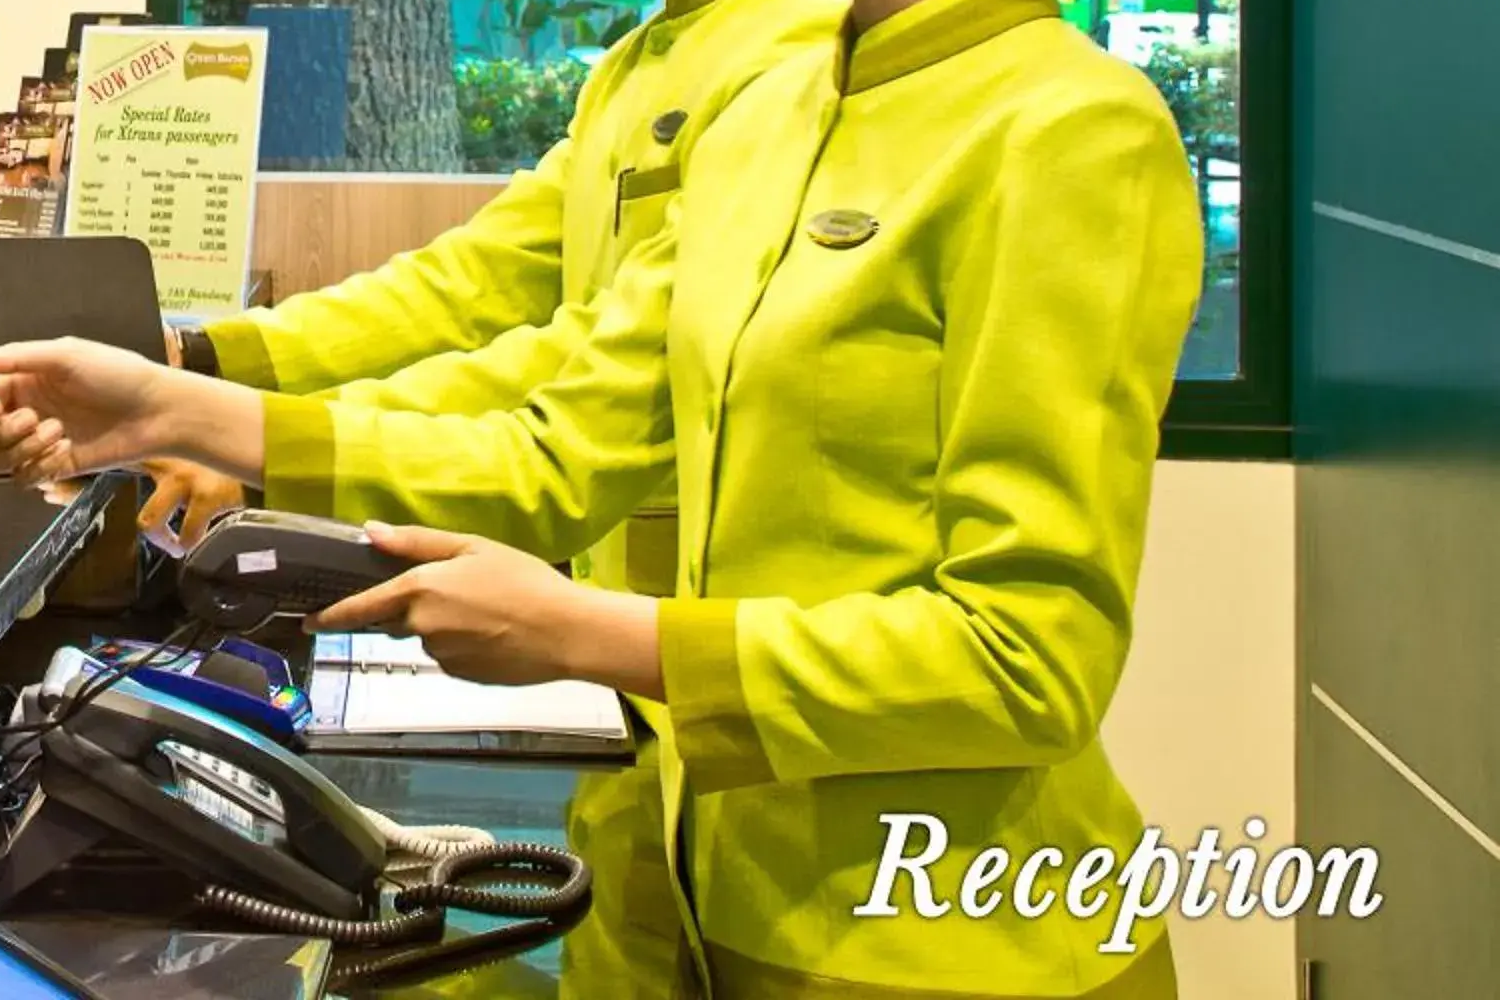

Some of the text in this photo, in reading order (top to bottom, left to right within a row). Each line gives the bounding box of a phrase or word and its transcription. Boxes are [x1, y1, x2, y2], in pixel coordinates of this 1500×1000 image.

[88, 41, 176, 104] NOW OPEN
[121, 105, 211, 125] Special Rates
[94, 125, 239, 147] for Xtrans passengers
